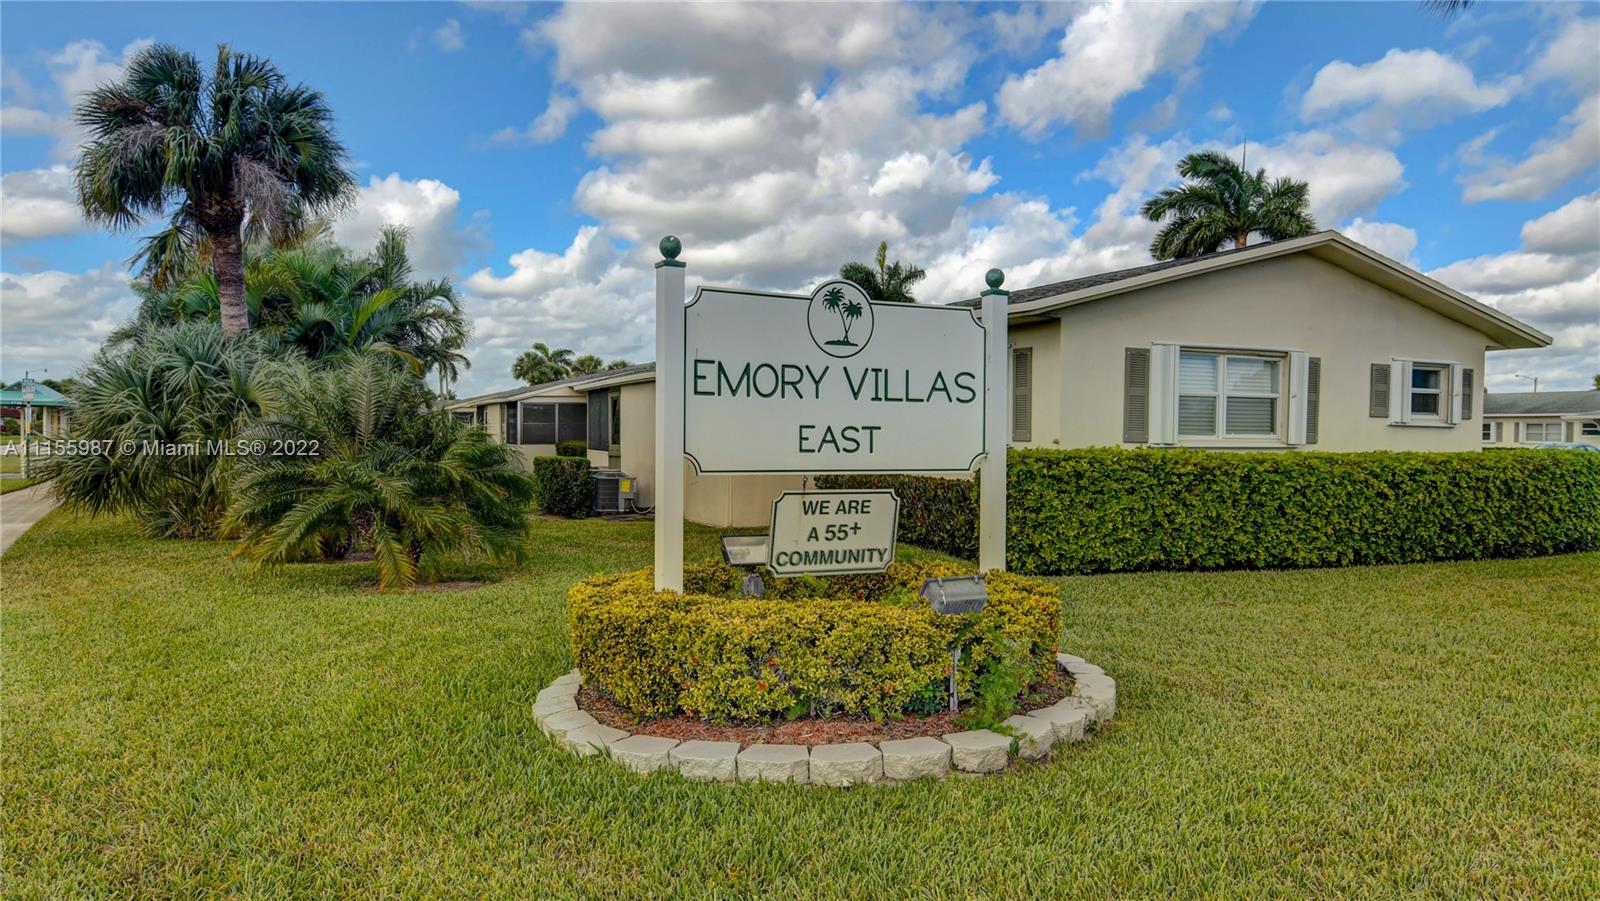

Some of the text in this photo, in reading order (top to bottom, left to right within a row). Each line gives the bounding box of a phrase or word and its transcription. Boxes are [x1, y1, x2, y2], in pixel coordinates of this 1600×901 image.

[693, 359, 977, 404] EMORY VILLAS
[799, 425, 882, 454] EAST
[802, 499, 872, 516] WE ARE
[807, 522, 862, 542] A 55+
[775, 548, 888, 568] COMMUNITY
